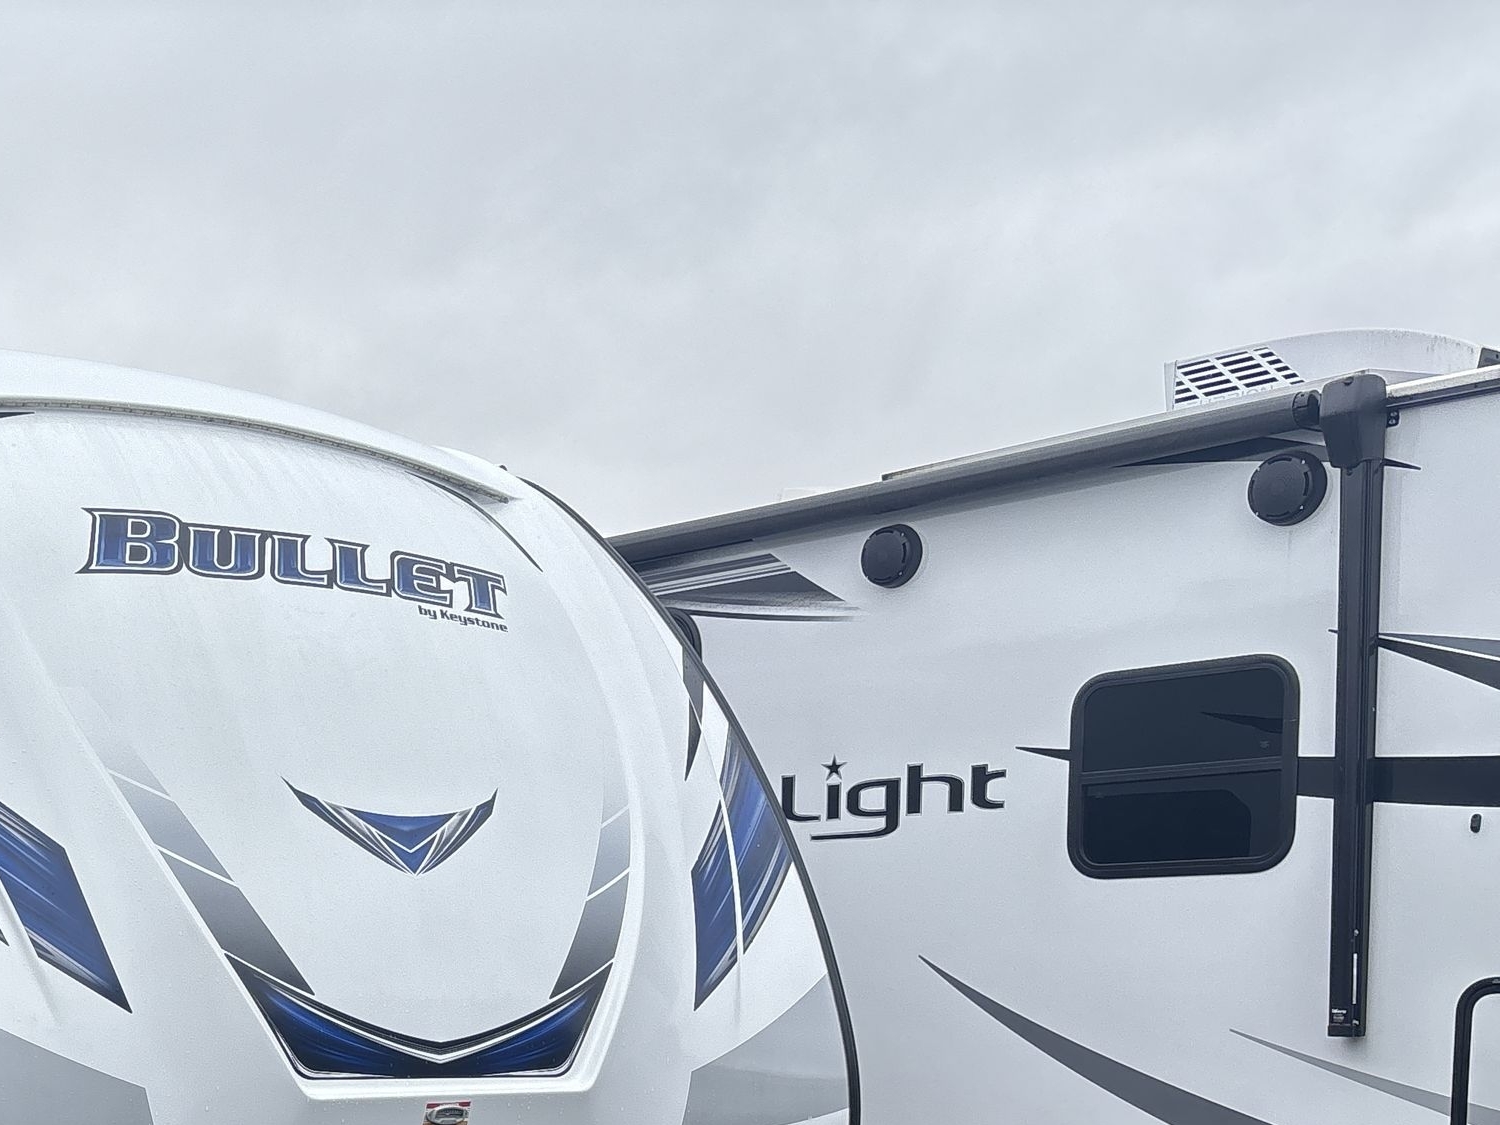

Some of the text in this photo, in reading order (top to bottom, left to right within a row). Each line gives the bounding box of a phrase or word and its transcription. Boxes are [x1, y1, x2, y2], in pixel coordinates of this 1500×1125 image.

[75, 507, 508, 619] BULLET
[418, 604, 509, 632] by Keystone
[780, 754, 1007, 841] Light
